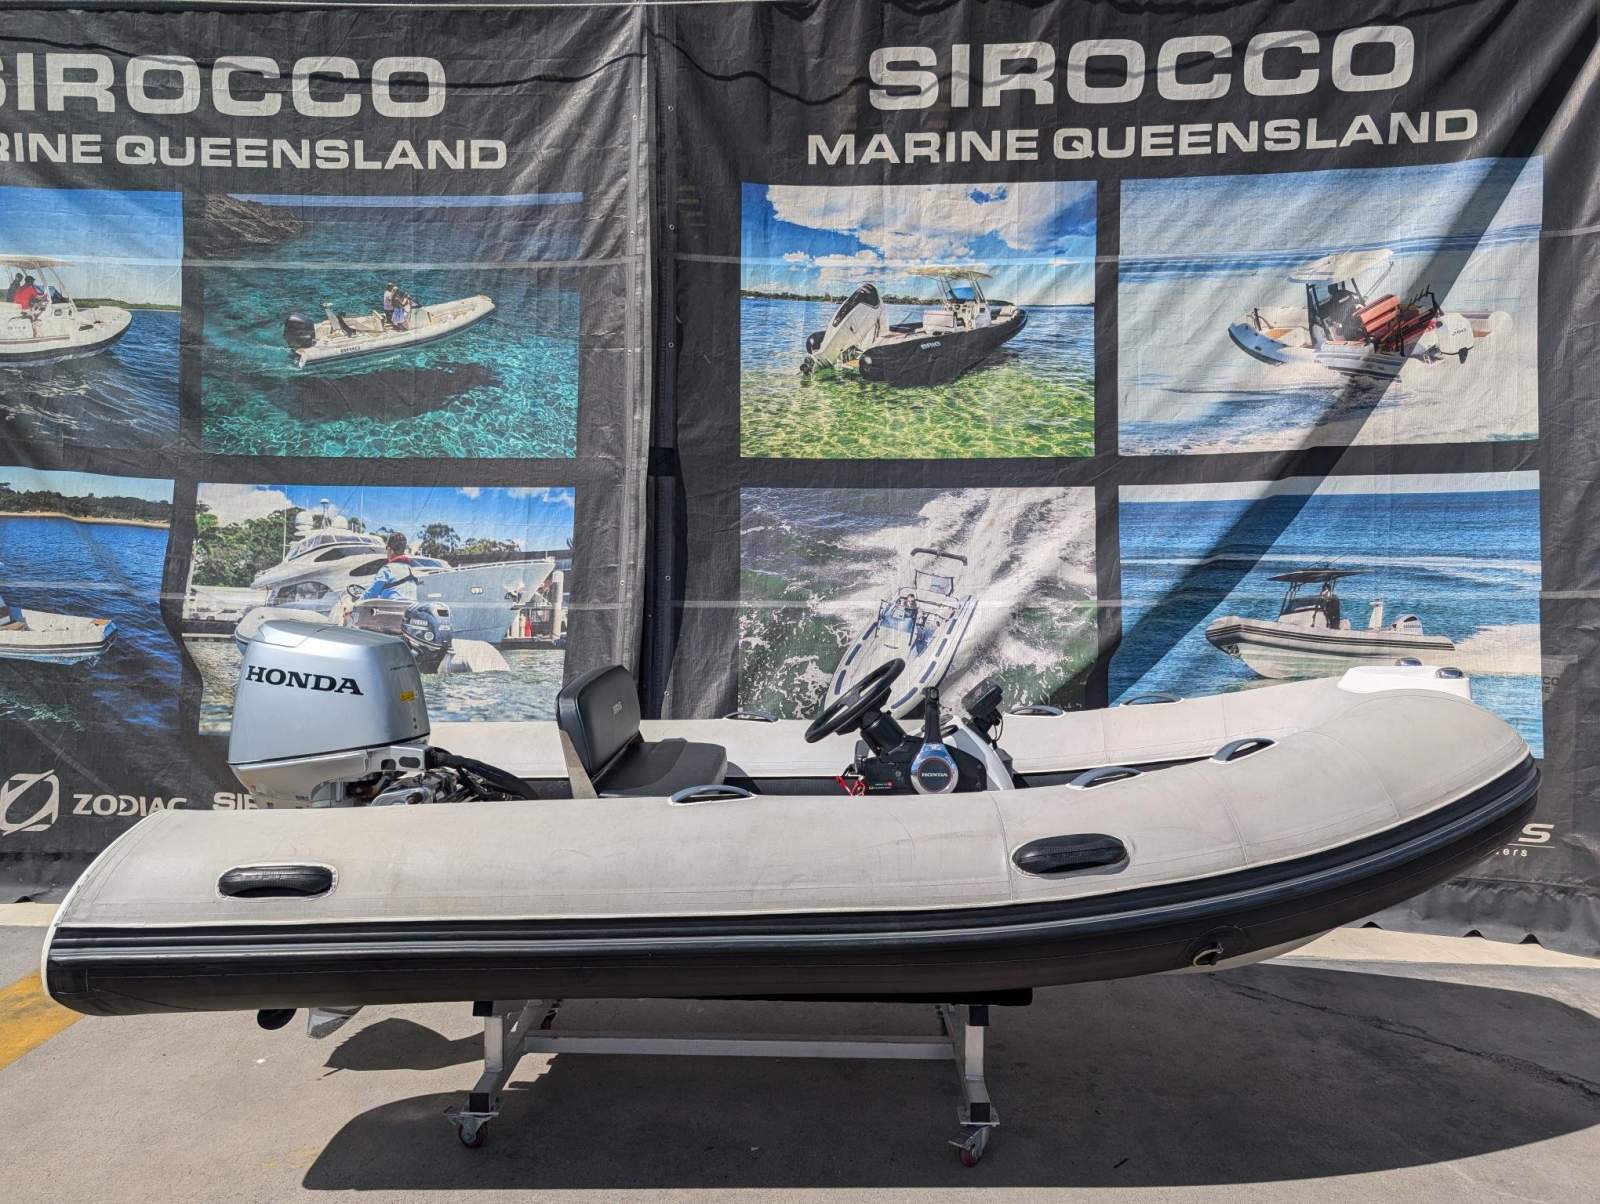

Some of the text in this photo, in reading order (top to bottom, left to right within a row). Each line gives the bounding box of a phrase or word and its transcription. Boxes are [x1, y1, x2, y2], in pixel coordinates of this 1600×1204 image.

[0, 53, 446, 118] IROCCO
[869, 26, 1415, 111] SIROCCO
[116, 136, 507, 169] QUEENSLAND
[808, 109, 1478, 166] MARINE QUEENSLAND
[245, 665, 364, 696] HONDA
